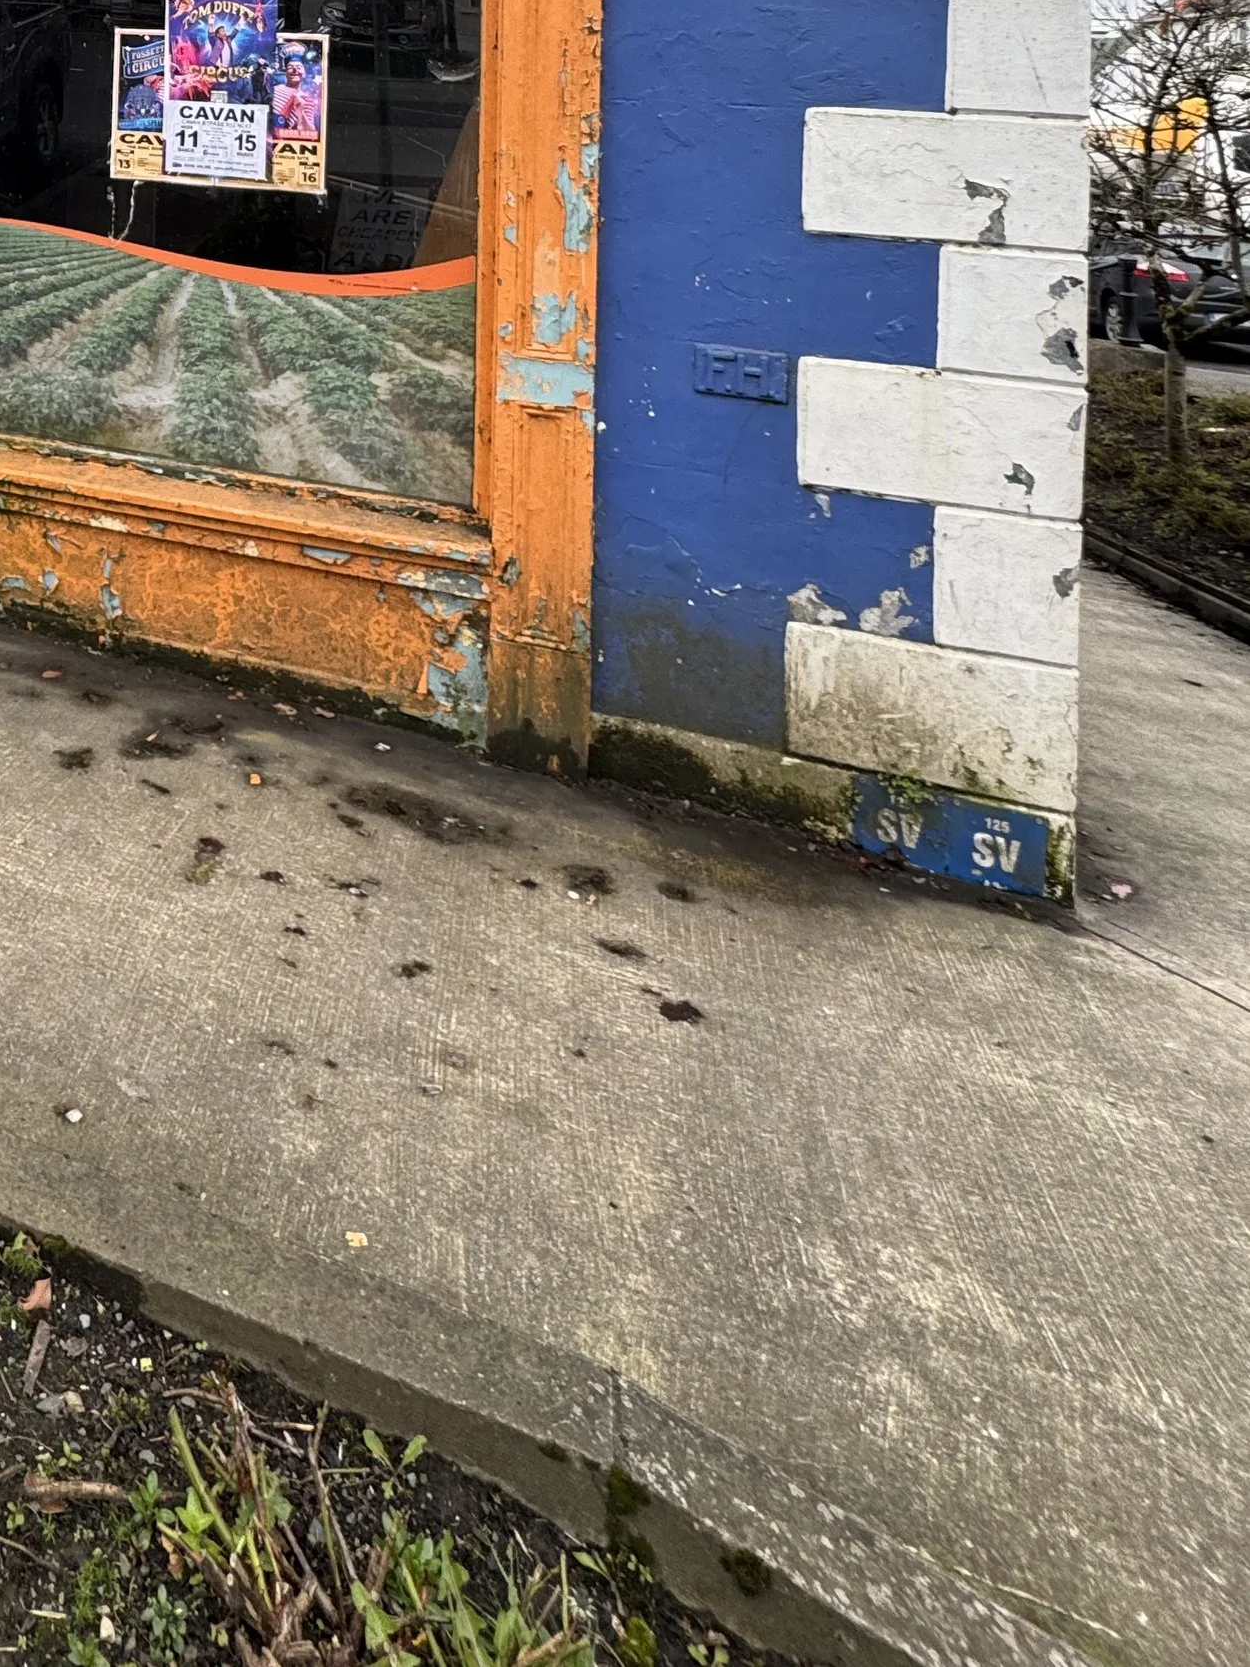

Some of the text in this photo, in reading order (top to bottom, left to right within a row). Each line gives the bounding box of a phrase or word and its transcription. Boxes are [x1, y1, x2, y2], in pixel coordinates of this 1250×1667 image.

[183, 2, 212, 31] TOM
[179, 105, 255, 123] CAVAN
[175, 129, 198, 148] 11
[234, 133, 257, 152] 15
[118, 159, 131, 169] 13
[302, 172, 317, 183] 16
[350, 209, 412, 225] ARE
[876, 808, 924, 849] SV
[984, 817, 1011, 834] 125
[971, 832, 1022, 873] SV
